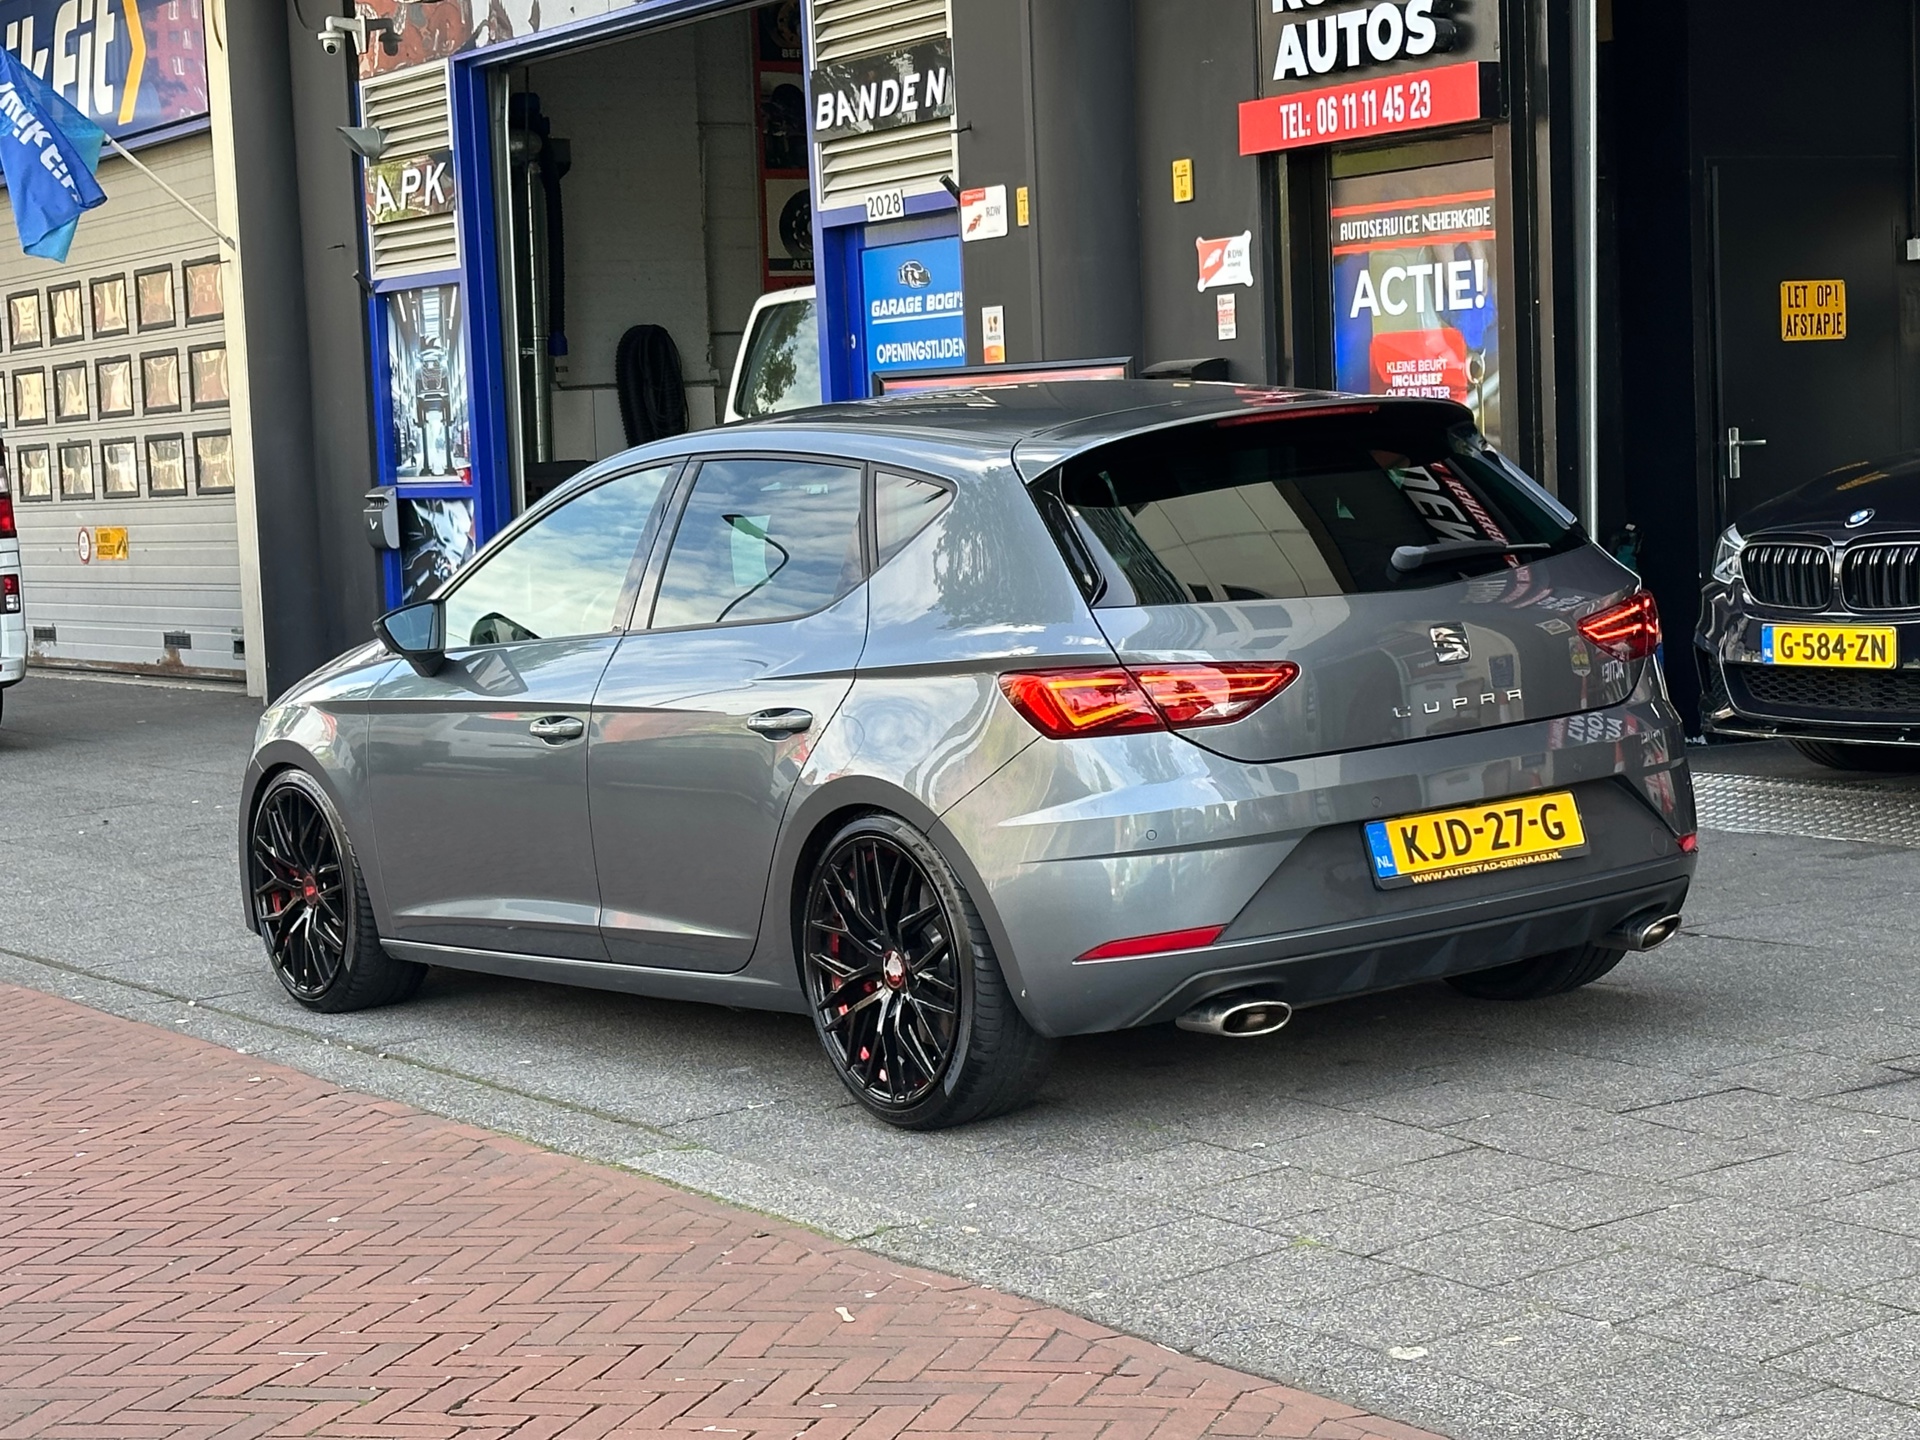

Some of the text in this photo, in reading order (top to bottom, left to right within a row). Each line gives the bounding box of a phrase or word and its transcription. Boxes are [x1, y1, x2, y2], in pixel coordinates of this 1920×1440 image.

[1273, 0, 1437, 80] AUTOS
[815, 67, 947, 131] BANDEN
[1280, 80, 1431, 140] TEL: 06 11 11 45 23
[376, 162, 446, 215] APK
[868, 193, 901, 217] 2028
[1422, 206, 1491, 232] NEHERKADE
[1350, 259, 1485, 318] ACTIE!
[1787, 285, 1808, 308] LET
[871, 296, 923, 317] GARAGE
[1786, 312, 1843, 336] AFSTAPJE
[1386, 358, 1448, 373] KLEINE BEURT
[1392, 373, 1443, 387] INCLUSIEF
[1780, 632, 1886, 662] G-584-ZN
[1393, 688, 1522, 718] CUPRA
[1400, 803, 1566, 864] KJD-27-G
[1376, 856, 1393, 868] NL
